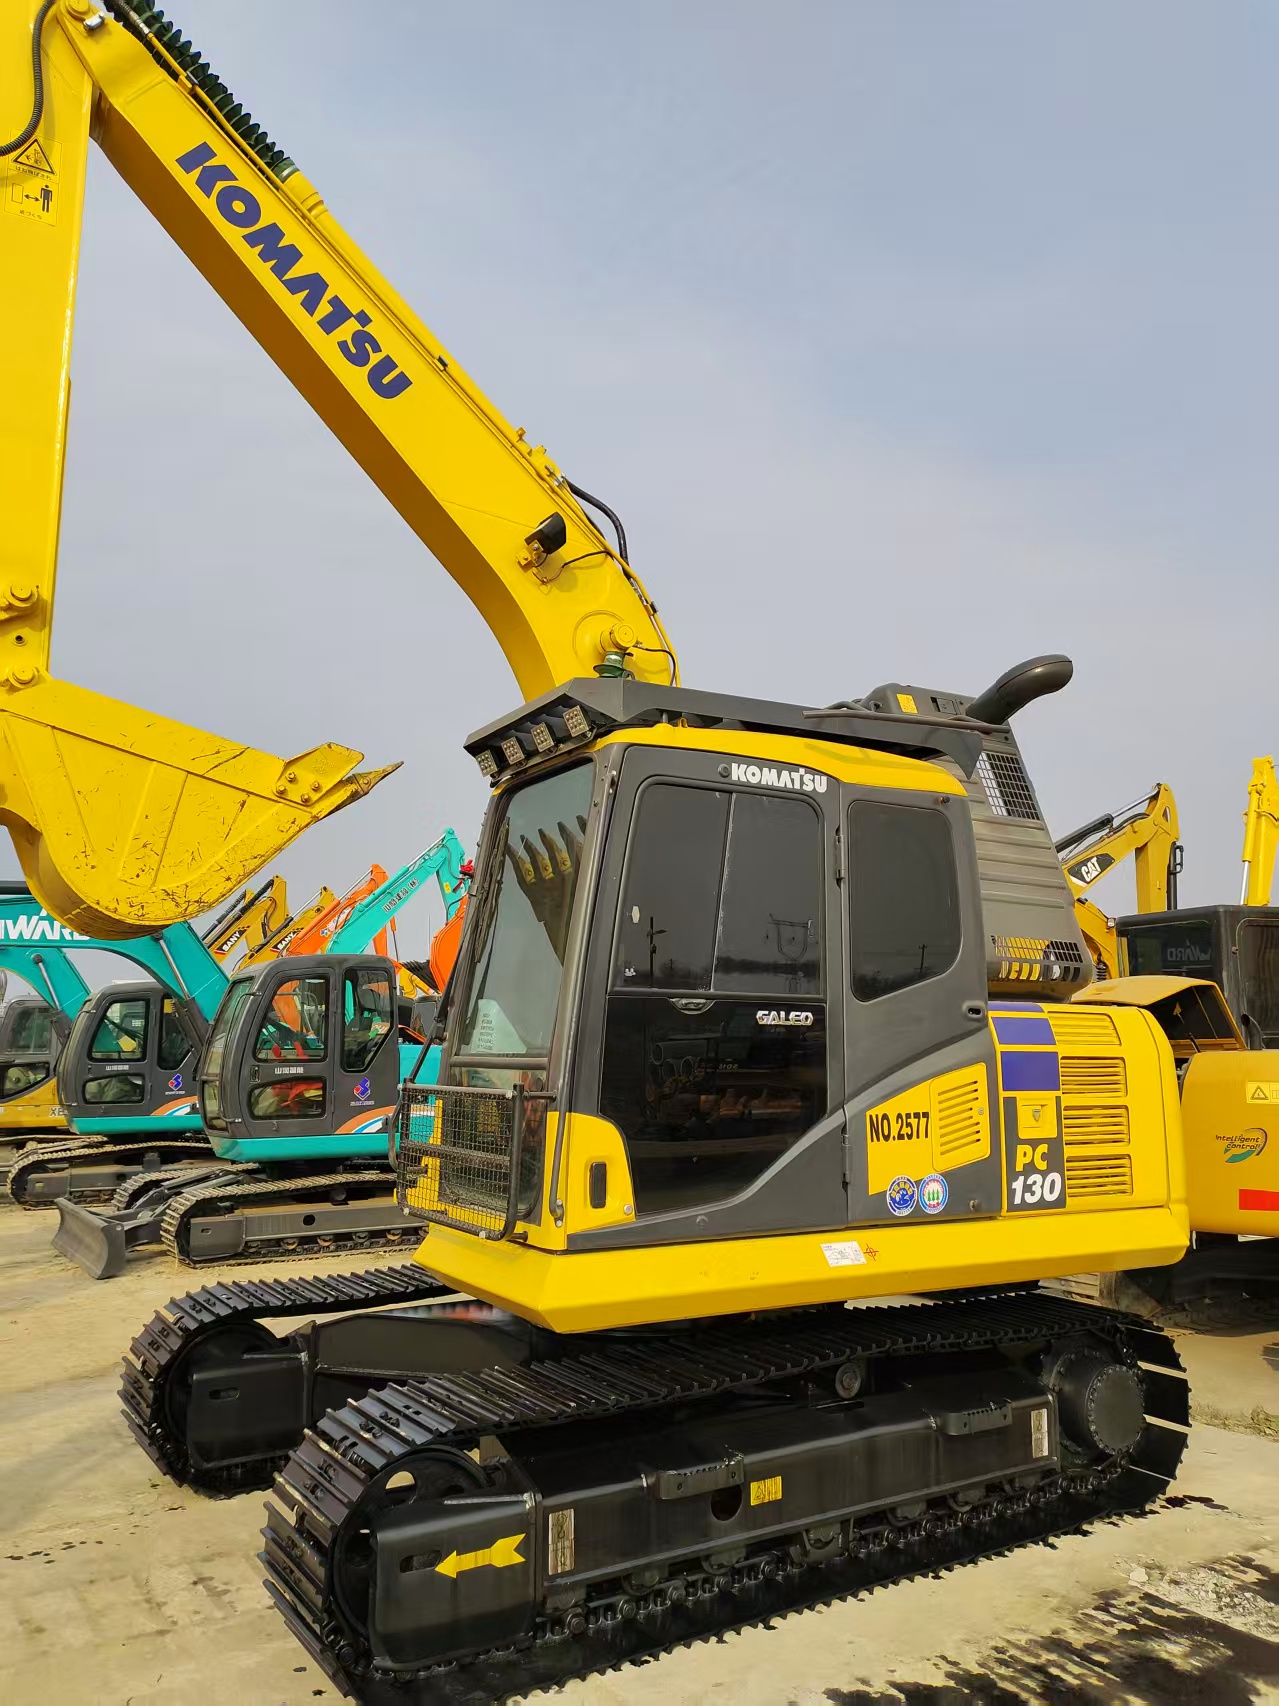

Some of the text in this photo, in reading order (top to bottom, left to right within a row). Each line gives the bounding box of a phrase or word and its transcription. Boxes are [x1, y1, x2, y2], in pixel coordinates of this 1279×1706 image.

[175, 141, 413, 399] KOMATSU
[731, 762, 828, 793] KOMATSU
[1081, 856, 1101, 881] CAT
[0, 907, 91, 940] WAR
[222, 930, 241, 952] SANY
[277, 931, 296, 950] SANY
[756, 1010, 814, 1026] GALEO
[869, 1112, 930, 1142] NO.2577
[1015, 1143, 1048, 1172] PC
[1011, 1172, 1062, 1205] 130
